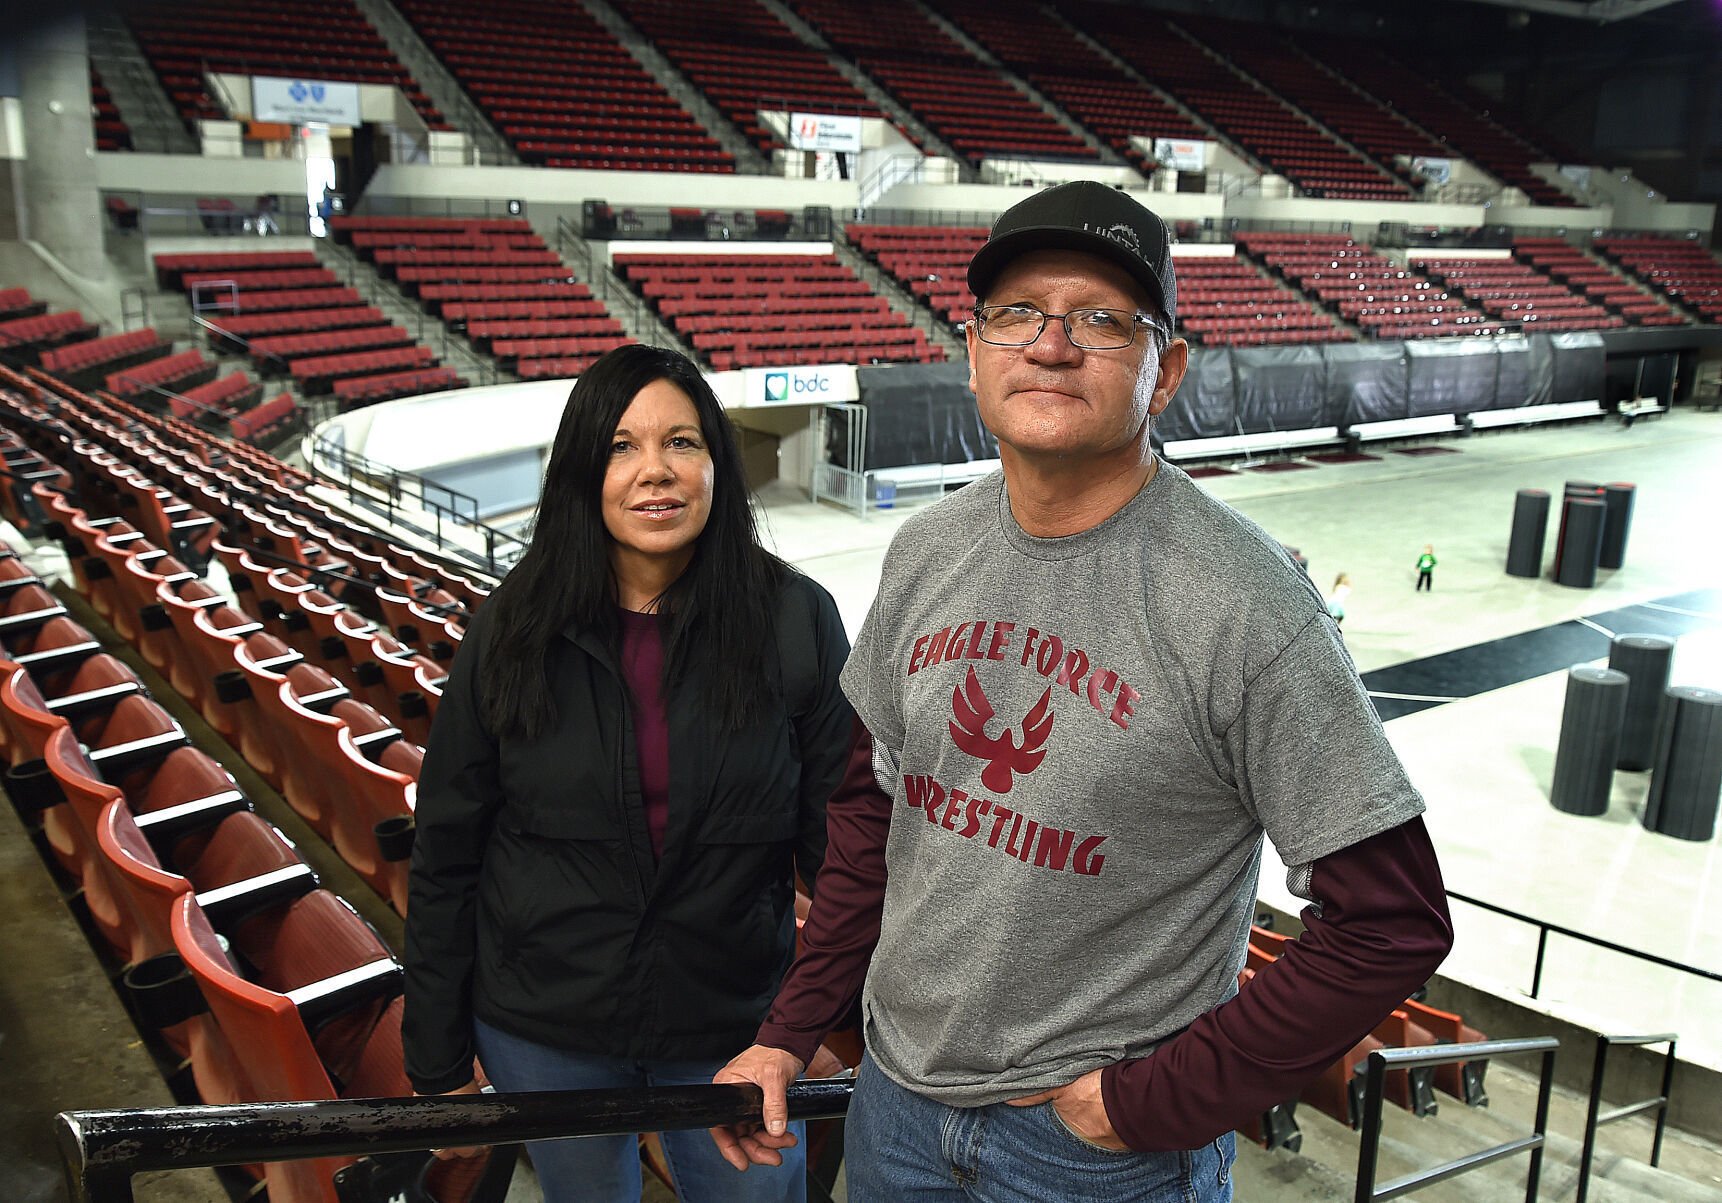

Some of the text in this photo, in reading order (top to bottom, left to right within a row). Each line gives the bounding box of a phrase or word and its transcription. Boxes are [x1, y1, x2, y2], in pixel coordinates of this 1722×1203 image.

[794, 373, 829, 392] bdc
[907, 620, 1142, 731] EAGLE FORCE
[903, 774, 1110, 877] WRESTLING
